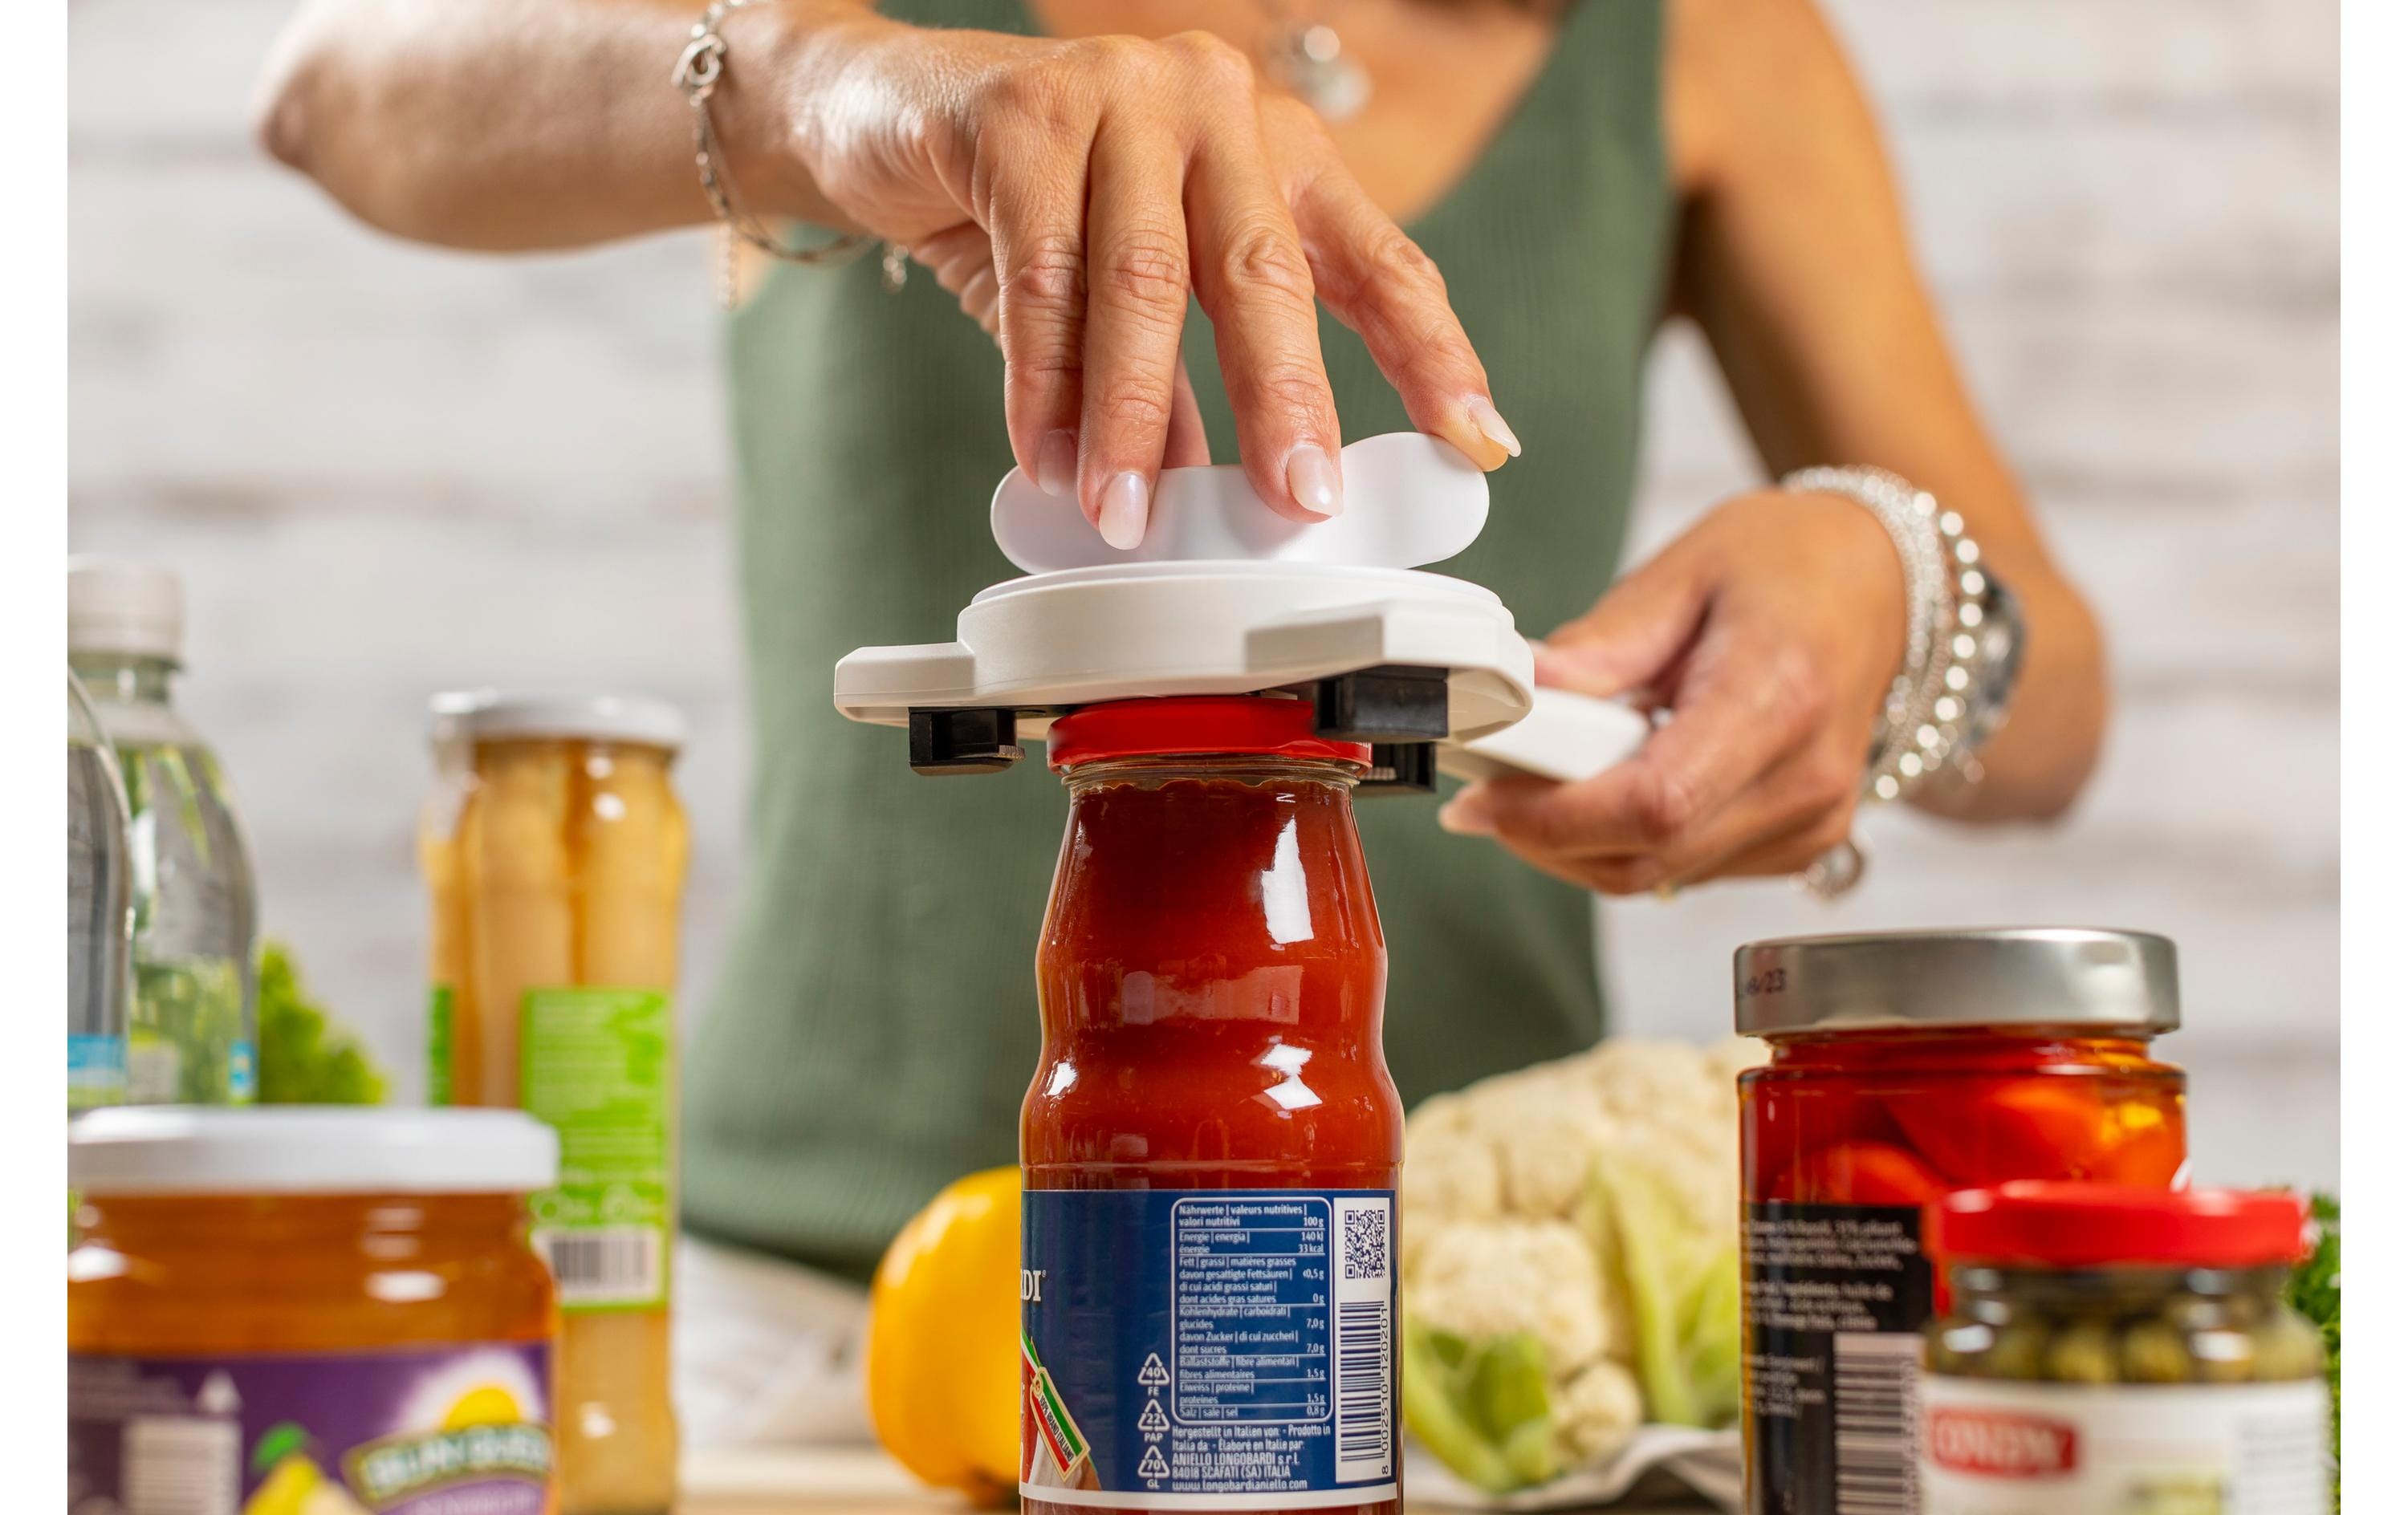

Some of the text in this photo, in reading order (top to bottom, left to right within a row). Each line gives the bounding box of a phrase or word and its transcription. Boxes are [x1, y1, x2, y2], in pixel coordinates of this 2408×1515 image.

[1179, 1204, 1304, 1215] Nährwerte valeurs nutritives
[1178, 1216, 1240, 1227] valori nutritivi
[1303, 1216, 1318, 1227] 100
[1178, 1232, 1246, 1243] Energie energia
[1301, 1232, 1316, 1241] 140
[1298, 1243, 1324, 1253] 33 kcal
[1179, 1257, 1297, 1268] Fett grassi matières grasses
[1178, 1269, 1204, 1279] davon
[1247, 1269, 1289, 1279] Fettsäuren
[1178, 1281, 1274, 1294] di cui acidi grassi saturi
[1178, 1294, 1198, 1304] dont
[1200, 1294, 1226, 1304] acides
[1227, 1295, 1246, 1305] gras
[1312, 1294, 1319, 1302] 0
[1178, 1306, 1287, 1318] Kohlenhydrate carboidrati
[1178, 1319, 1214, 1330] glucides
[1178, 1330, 1295, 1342] davon Zucker di cui zuccheri
[1178, 1345, 1227, 1354] dont sucres
[1178, 1356, 1295, 1367] Ballaststoffe fibre alimentari
[1146, 1367, 1161, 1378] 40
[1179, 1369, 1255, 1379] fibres alimentaires
[1147, 1386, 1159, 1396] FE
[1179, 1382, 1250, 1393] Eiweiss proteine
[1381, 1306, 1389, 1475] 8 002510 120201
[1179, 1407, 1239, 1417] Salz sale sel
[1146, 1413, 1161, 1424] 22
[1039, 1394, 1075, 1464] 100% BRAND ITALIANO
[1172, 1424, 1222, 1439] Hergestellt
[1222, 1424, 1232, 1437] in
[1234, 1425, 1263, 1437] Italien
[1288, 1424, 1322, 1436] Prodotto
[1323, 1424, 1331, 1436] in
[1145, 1432, 1163, 1443] PAP
[1172, 1440, 1195, 1452] Italia
[1253, 1441, 1263, 1450] en
[1265, 1438, 1287, 1450] Italie
[1172, 1452, 1212, 1465] ANIELLO
[1214, 1452, 1275, 1465] LONGOBARDI
[1146, 1459, 1161, 1471] 70
[1172, 1464, 1291, 1479] 84018 SCAFATI (SA) ITALIA
[1146, 1479, 1160, 1489] GL
